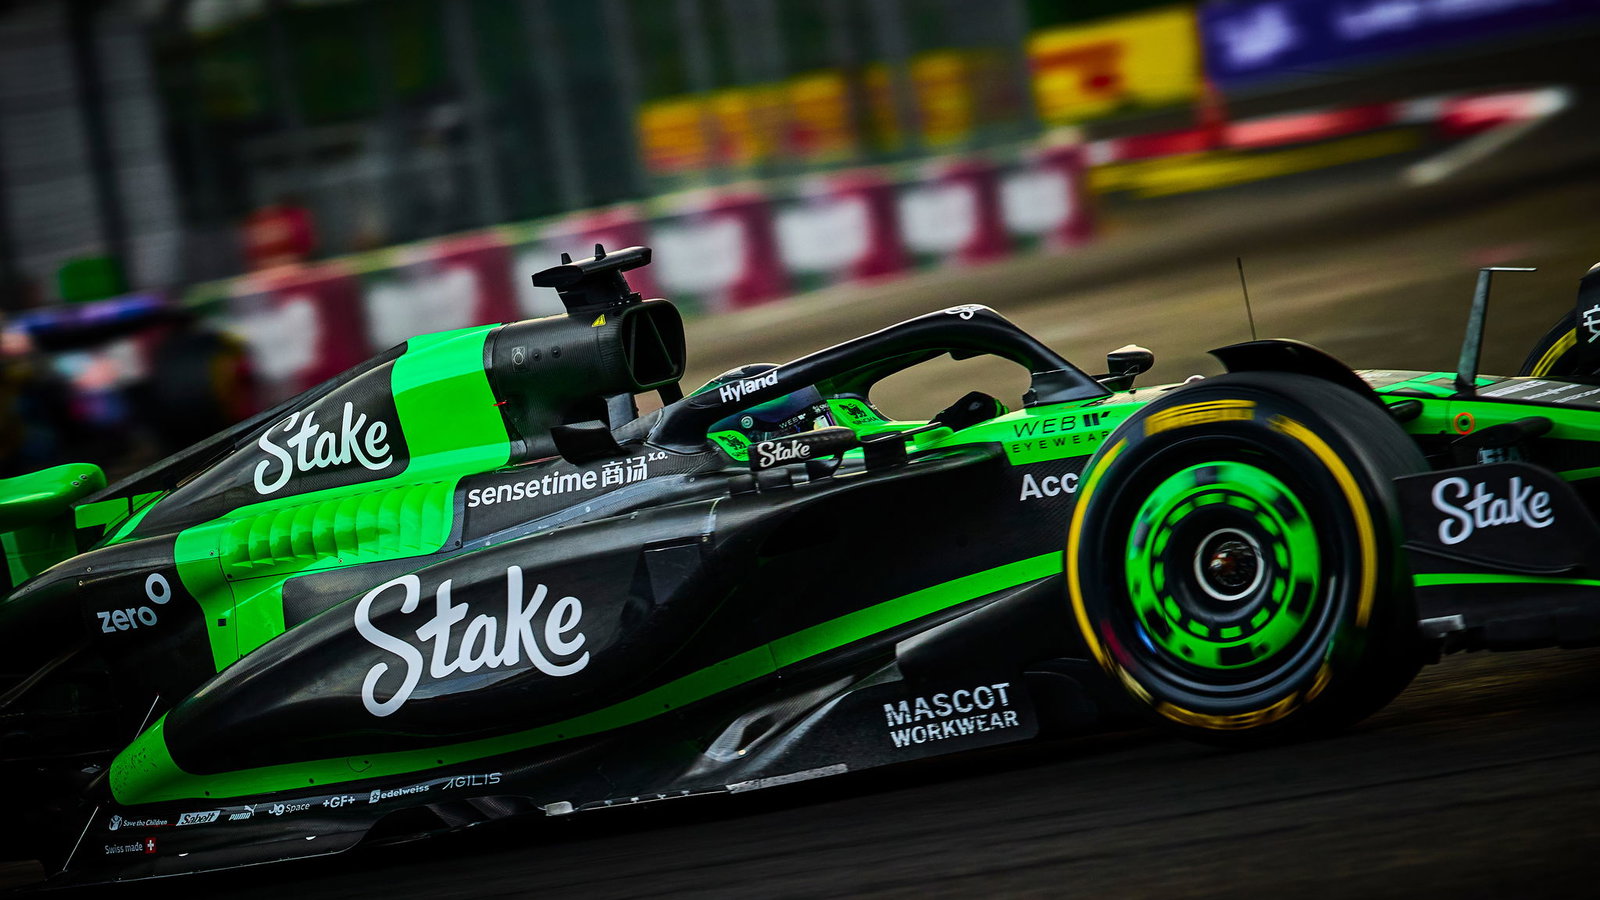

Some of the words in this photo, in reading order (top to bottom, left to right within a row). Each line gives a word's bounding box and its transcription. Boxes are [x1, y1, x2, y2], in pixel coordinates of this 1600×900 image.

[719, 370, 778, 403] Hyland
[1014, 415, 1076, 438] WEB
[253, 401, 392, 495] Stake
[757, 440, 811, 468] Stake
[467, 470, 597, 507] sensetime
[1431, 477, 1554, 545] Stake
[354, 565, 590, 717] Stake
[883, 682, 1010, 727] MASCOT
[890, 710, 1019, 748] WORKWEAR
[381, 785, 429, 799] edelweiss
[442, 772, 502, 790] AGILIS
[285, 802, 310, 813] Space
[104, 844, 124, 855] Swiss
[125, 842, 143, 853] made
